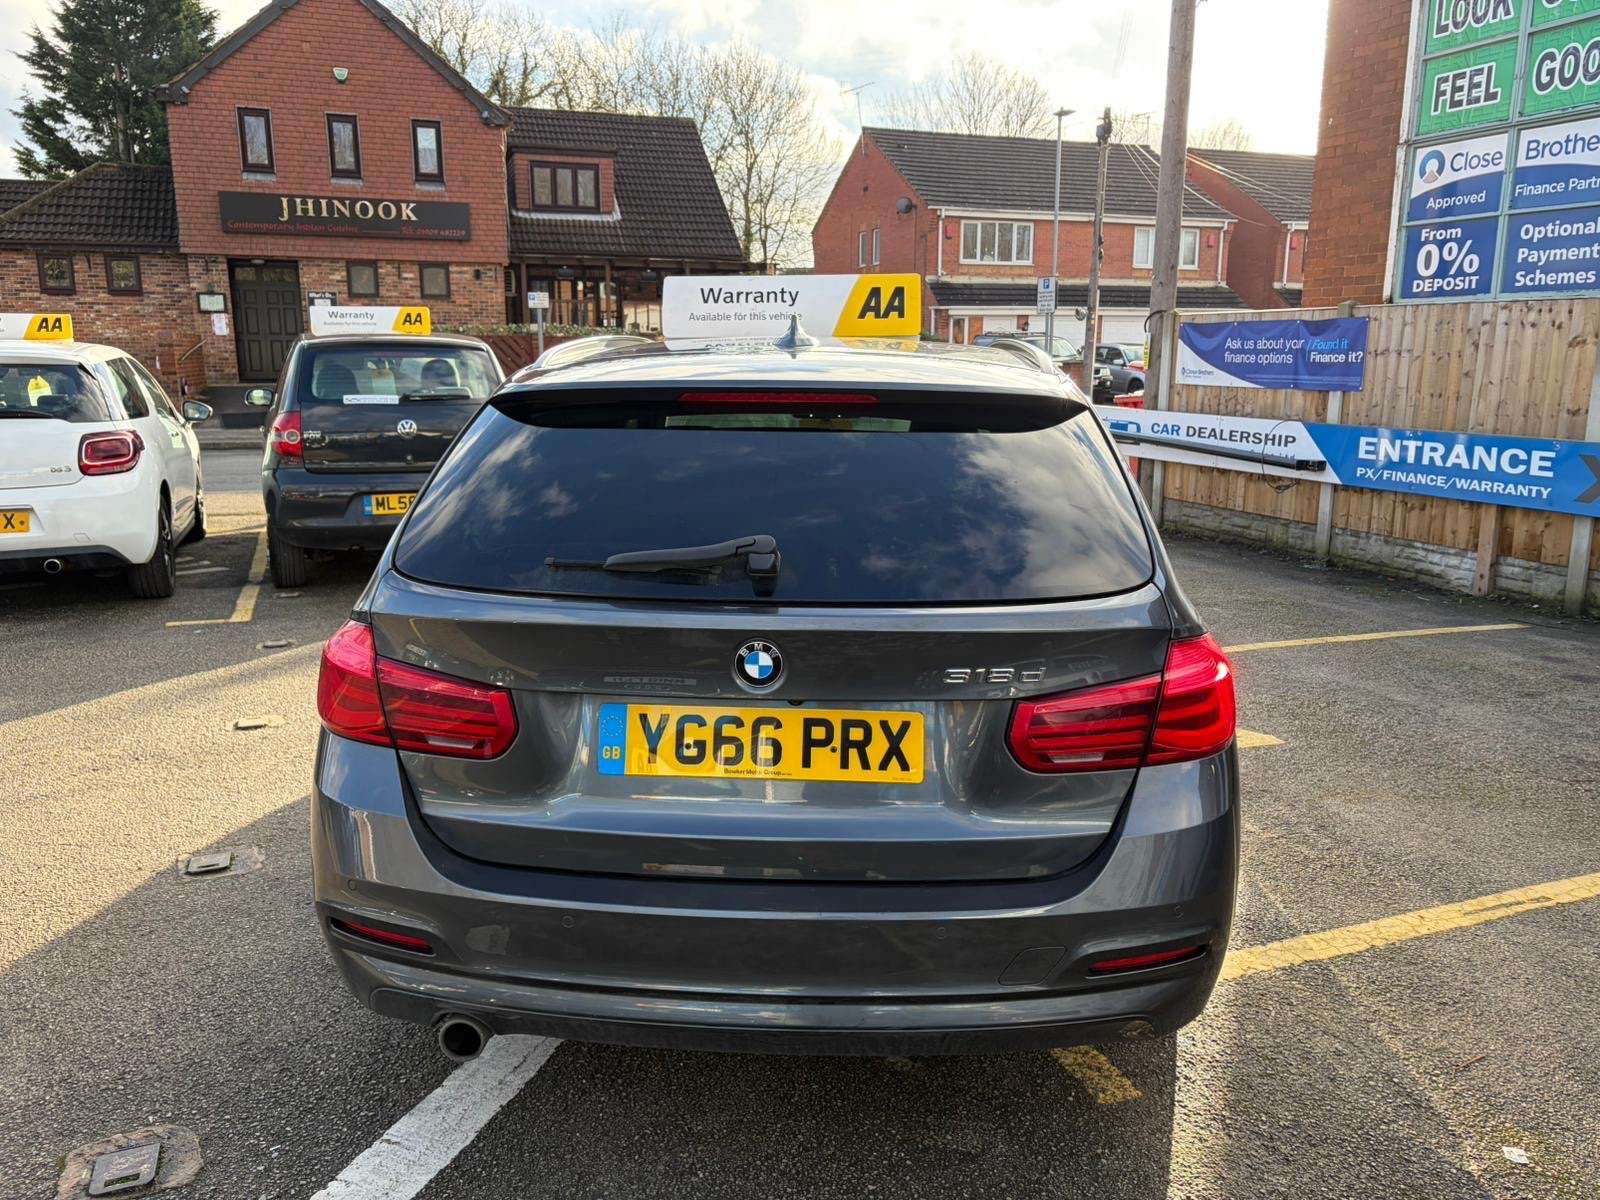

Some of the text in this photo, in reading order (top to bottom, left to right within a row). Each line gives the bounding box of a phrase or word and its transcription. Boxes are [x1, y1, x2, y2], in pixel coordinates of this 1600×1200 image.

[1431, 63, 1501, 115] FEEL
[1450, 151, 1503, 172] Close
[1515, 180, 1564, 197] Finance
[1426, 191, 1486, 209] Approved
[279, 198, 418, 221] JHINOOK
[1421, 227, 1462, 242] From
[1520, 217, 1600, 242] Optional
[1416, 240, 1480, 277] 0%
[1412, 276, 1479, 292] DEPOSIT
[1515, 269, 1596, 287] Schemes
[700, 286, 905, 319] Warranty AA
[37, 318, 62, 332] AA
[328, 311, 422, 325] Warranty AA
[689, 312, 802, 321] Available for this vehice
[1224, 338, 1242, 349] Ask
[1244, 340, 1254, 349] us
[1256, 337, 1283, 349] about
[1311, 338, 1349, 350] Found it
[1224, 352, 1293, 364] finance options
[1310, 351, 1363, 363] Finance it?
[1151, 422, 1297, 447] CAR DEALERSHIP
[1358, 436, 1556, 478] ENTRANCE
[1356, 467, 1552, 499] PX/FINANCE/WARRANTY
[638, 713, 911, 771] YG66 PRX
[602, 746, 621, 760] GB
